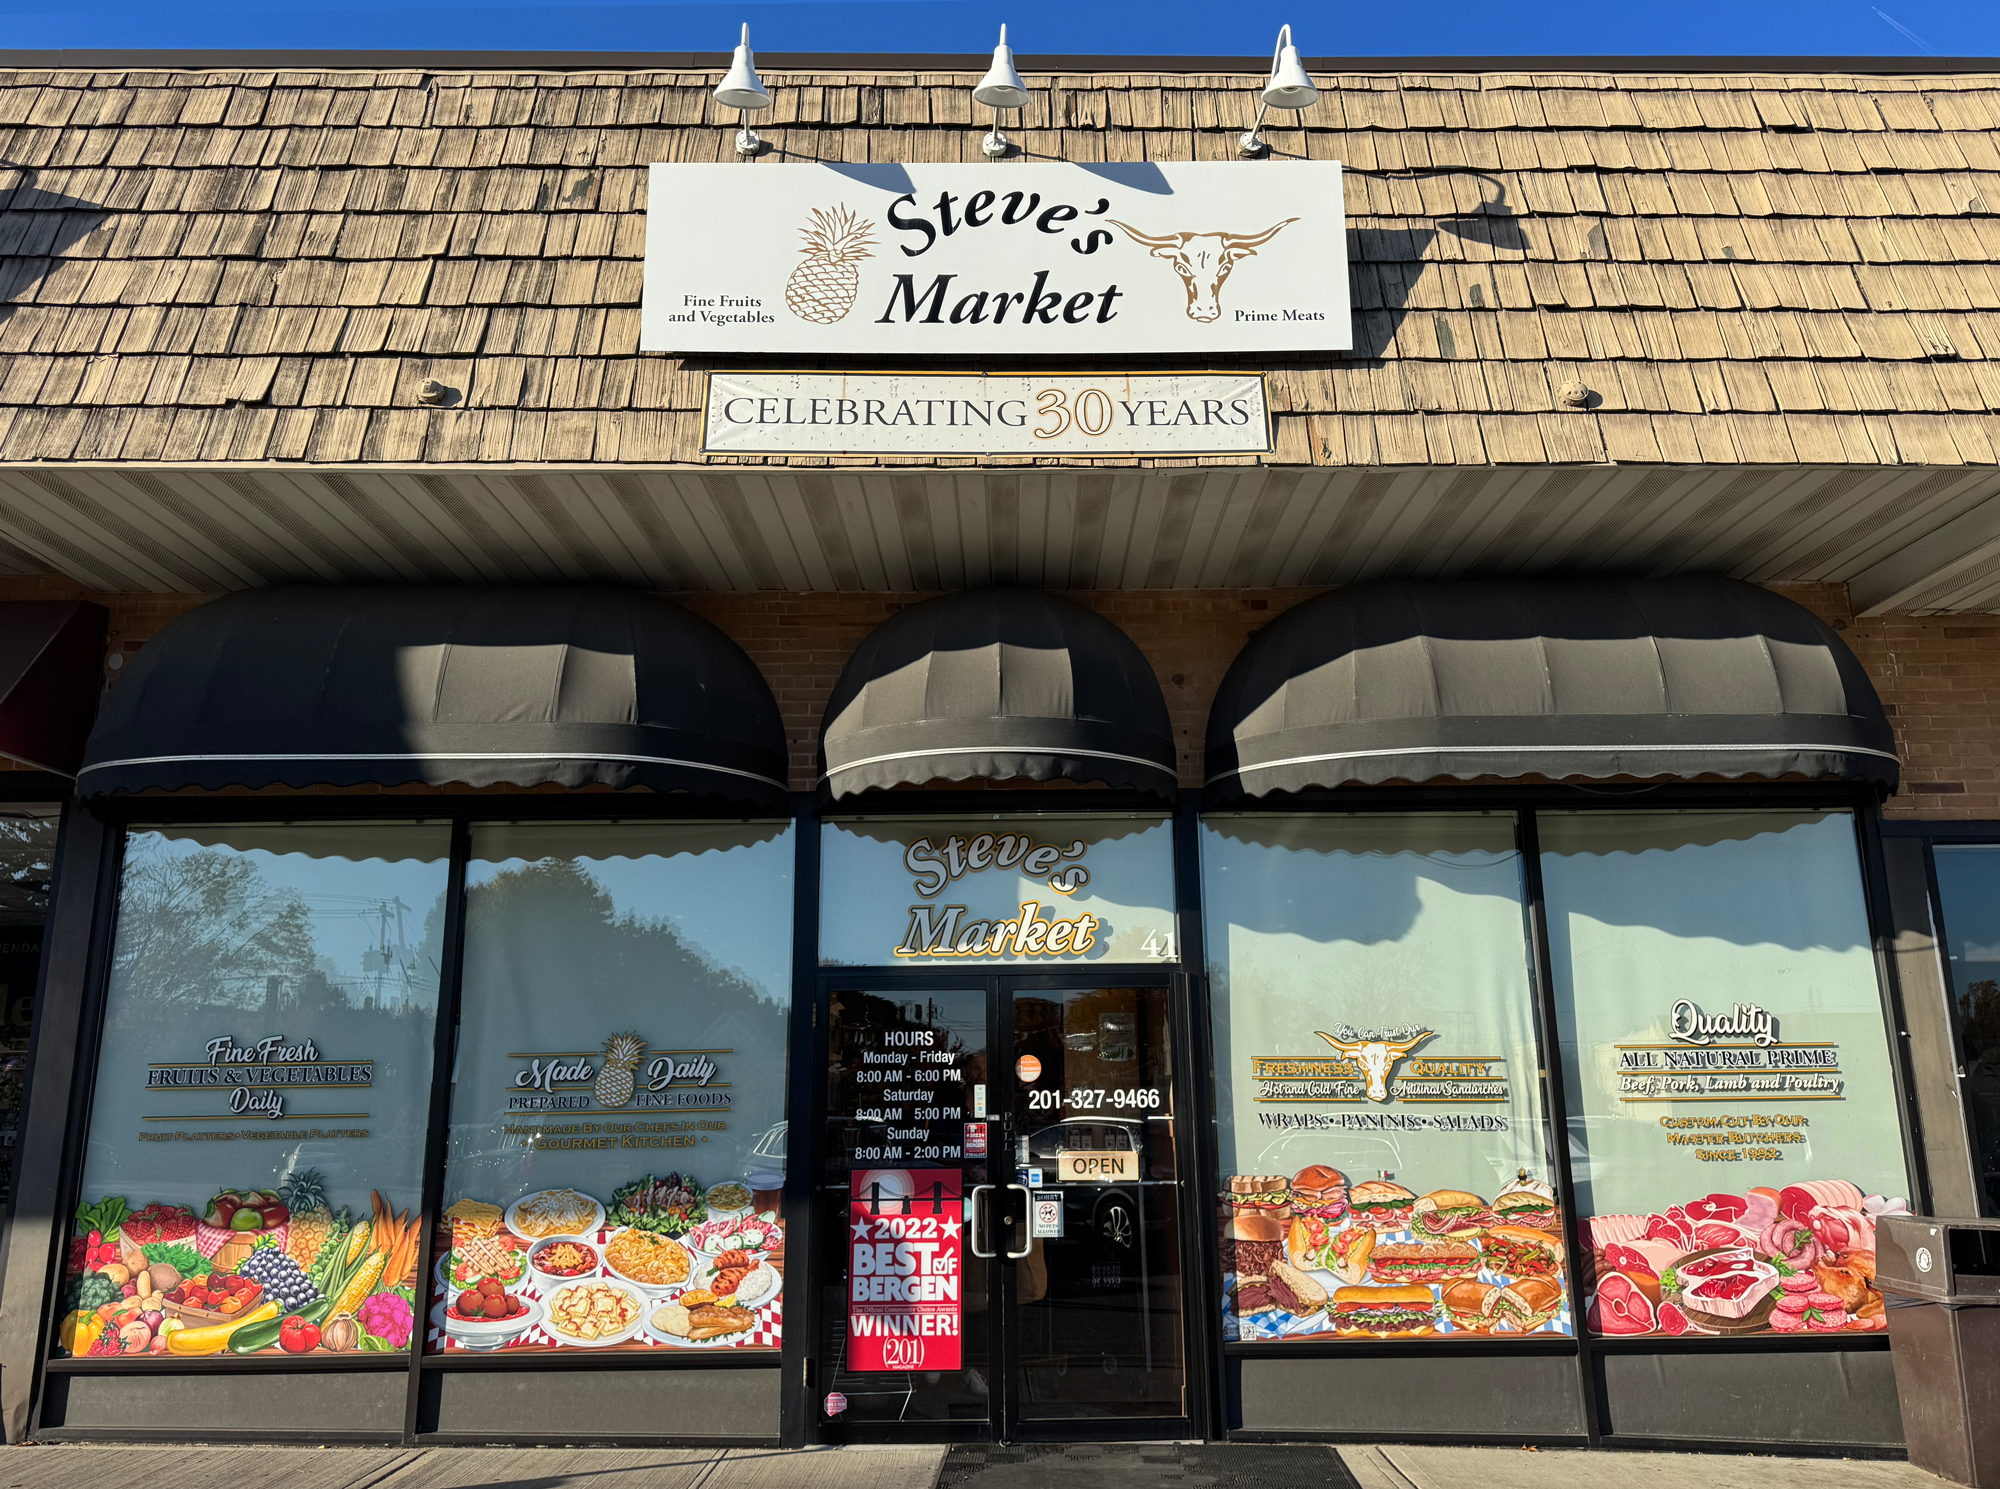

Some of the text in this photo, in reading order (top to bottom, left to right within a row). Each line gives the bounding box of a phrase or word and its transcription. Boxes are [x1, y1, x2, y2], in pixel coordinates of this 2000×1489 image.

[886, 188, 1114, 257] Steve's
[683, 295, 762, 308] Fine Fruits
[875, 269, 1123, 325] Market
[668, 311, 775, 327] and Vegetables
[1234, 309, 1325, 322] Prime Meats
[723, 389, 1251, 439] CELEBRATING 30 YEARS
[903, 832, 1091, 898] Steve's
[894, 900, 1098, 957] Market
[1140, 928, 1179, 958] 41
[1333, 1022, 1354, 1037] You
[1357, 1026, 1376, 1038] Can
[1378, 1026, 1400, 1038] Trust
[1668, 998, 1779, 1047] Quality
[884, 1030, 934, 1047] HOURS
[205, 1035, 318, 1067] Fine Fresh
[863, 1051, 908, 1066] Monday
[920, 1050, 955, 1066] Friday
[1619, 1049, 1835, 1068] ALL NATURAL PRIME
[146, 1065, 373, 1086] FRUITS & VEGETABLES
[514, 1057, 595, 1094] Made
[647, 1054, 718, 1092] Daily
[1252, 1061, 1355, 1074] FRESHNESS
[1410, 1061, 1486, 1075] QUALITY
[856, 1070, 883, 1083] 8:00
[884, 1070, 903, 1082] AM
[914, 1069, 940, 1082] 6:00
[942, 1069, 961, 1082] PM
[1620, 1073, 1839, 1094] Beef, Pork, Lamb and Poultry
[883, 1088, 934, 1104] Saturday
[1259, 1081, 1360, 1097] Hot and Cold Fine
[1442, 1081, 1504, 1096] Sandwiches
[228, 1086, 284, 1119] Daily
[508, 1096, 590, 1110] PREPARED
[635, 1092, 732, 1107] FINE FOODS
[1029, 1089, 1160, 1110] 201-327-9466
[856, 1107, 961, 1121] 8:00 AM 5:00 PM
[1258, 1113, 1504, 1129] WRAPS PANINIS SALADS
[1660, 1114, 1804, 1127] CUSTOM CUT BY OUR
[504, 1124, 580, 1134] HANDMADE
[603, 1122, 633, 1133] OUR
[634, 1121, 678, 1132] CHEFS
[697, 1120, 726, 1131] OUR
[887, 1127, 930, 1143] Sunday
[1003, 1112, 1013, 1151] PULL
[139, 1131, 173, 1142] FRUIT
[534, 1135, 695, 1150] GOURMET KITCHEN
[1667, 1131, 1802, 1144] MASTER BUTCHERS
[855, 1146, 882, 1160] 8:00
[883, 1146, 902, 1159] AM
[914, 1146, 940, 1159] 2:00
[942, 1146, 961, 1159] PM
[1695, 1148, 1778, 1160] SINCE 1992
[1072, 1157, 1124, 1174] OPEN
[874, 1217, 938, 1239] 2022
[853, 1242, 939, 1276] BEST
[852, 1275, 958, 1302] BERGEN
[851, 1314, 958, 1337] WINNER!
[883, 1336, 925, 1368] (201)
